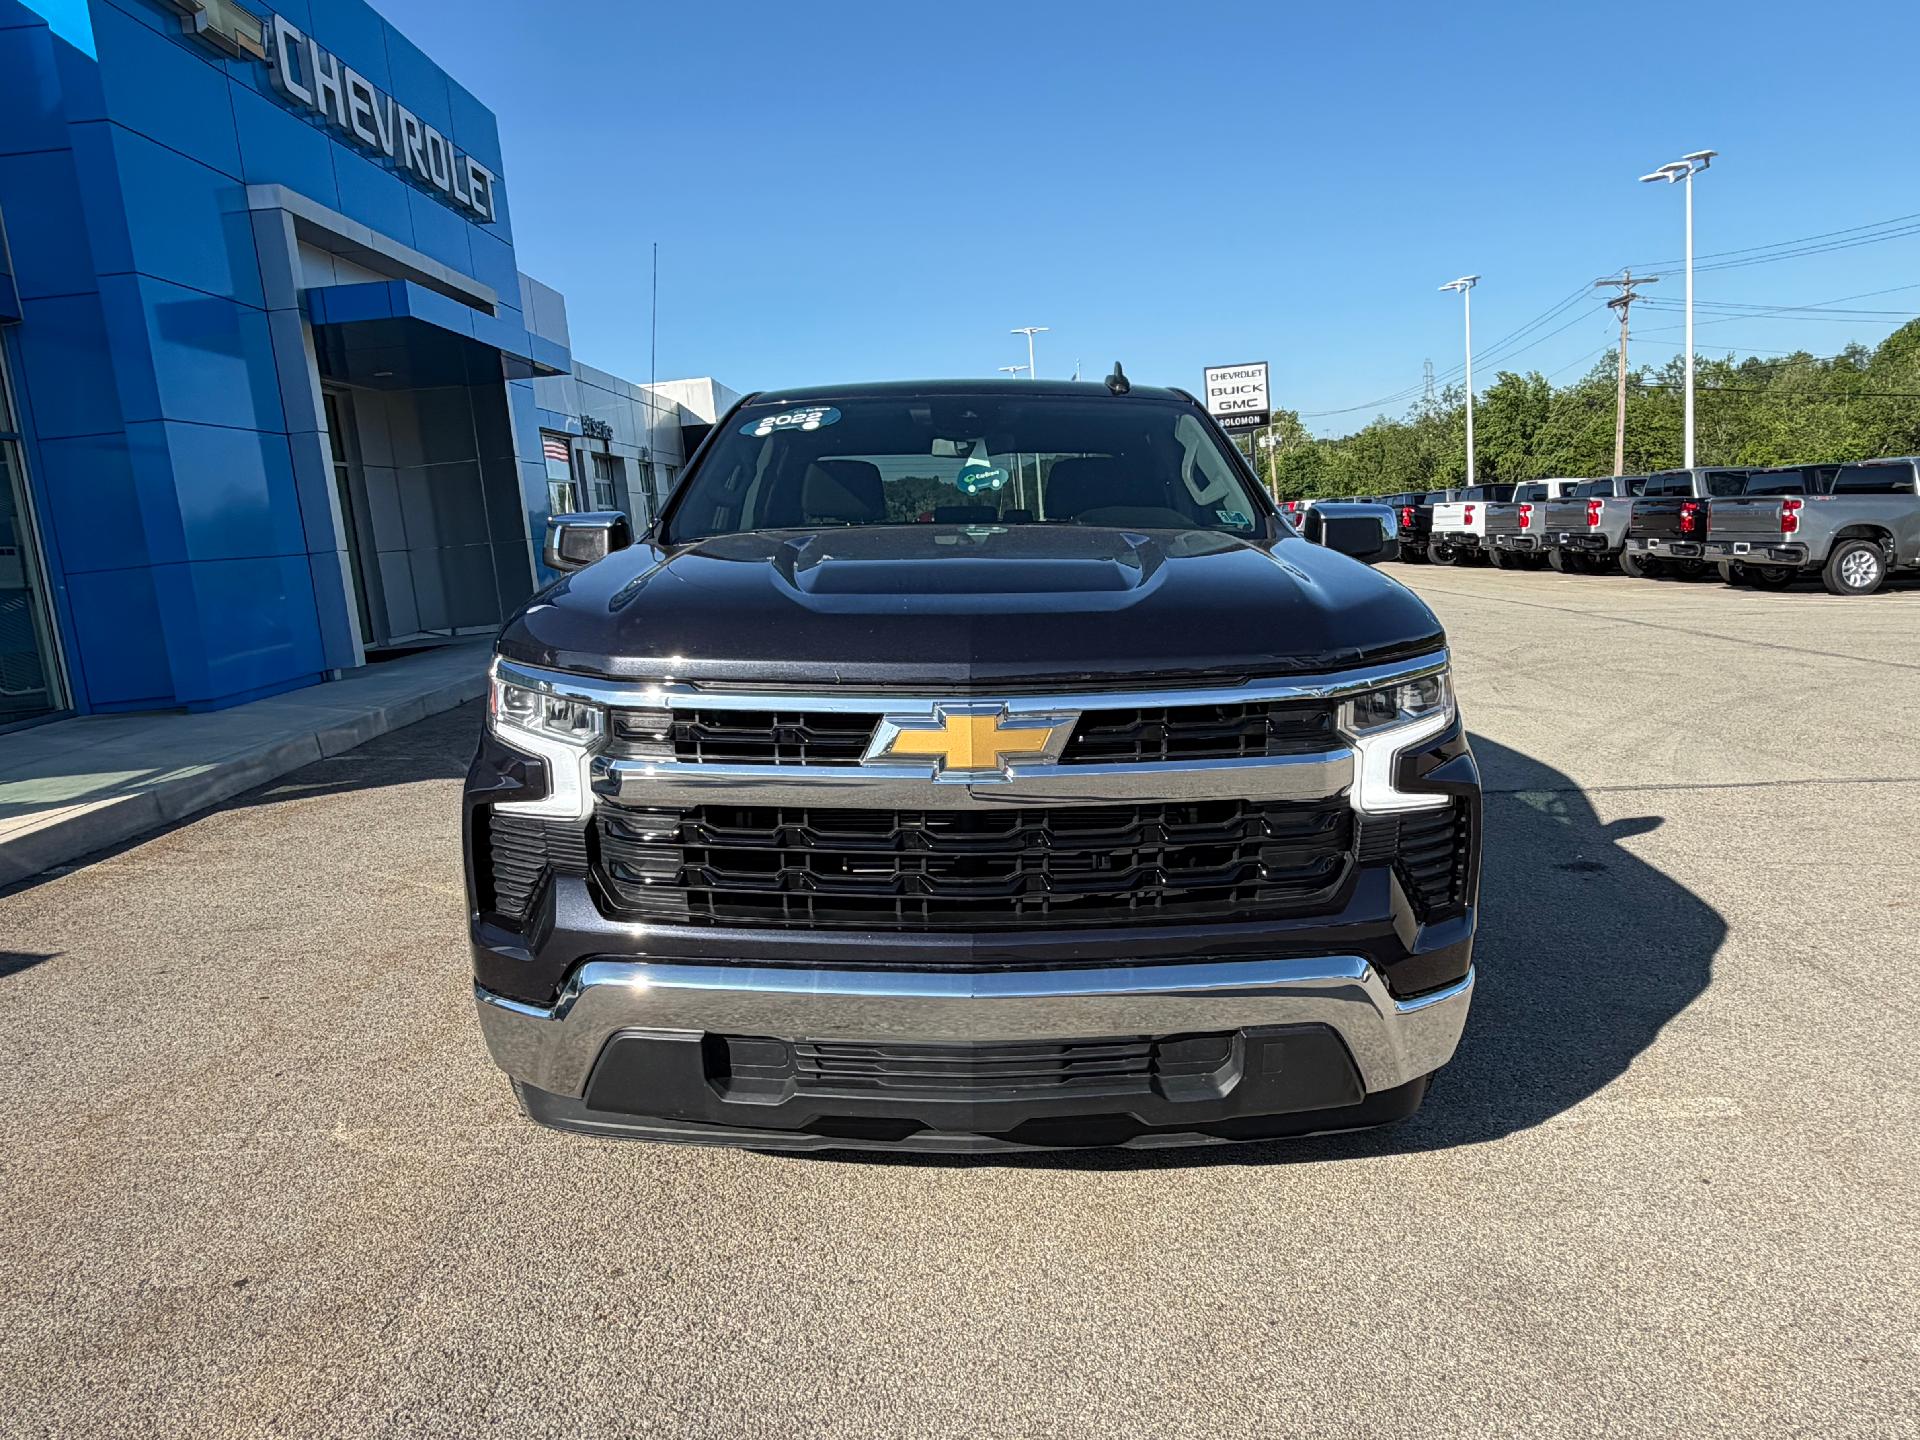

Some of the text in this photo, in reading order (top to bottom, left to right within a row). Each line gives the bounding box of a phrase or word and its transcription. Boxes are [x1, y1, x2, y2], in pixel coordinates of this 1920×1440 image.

[274, 14, 497, 223] CHEVROLET
[1210, 369, 1262, 381] CHEVROLET
[1211, 384, 1264, 396] BUICK
[1219, 398, 1258, 410] GMC
[760, 412, 822, 427] 2022
